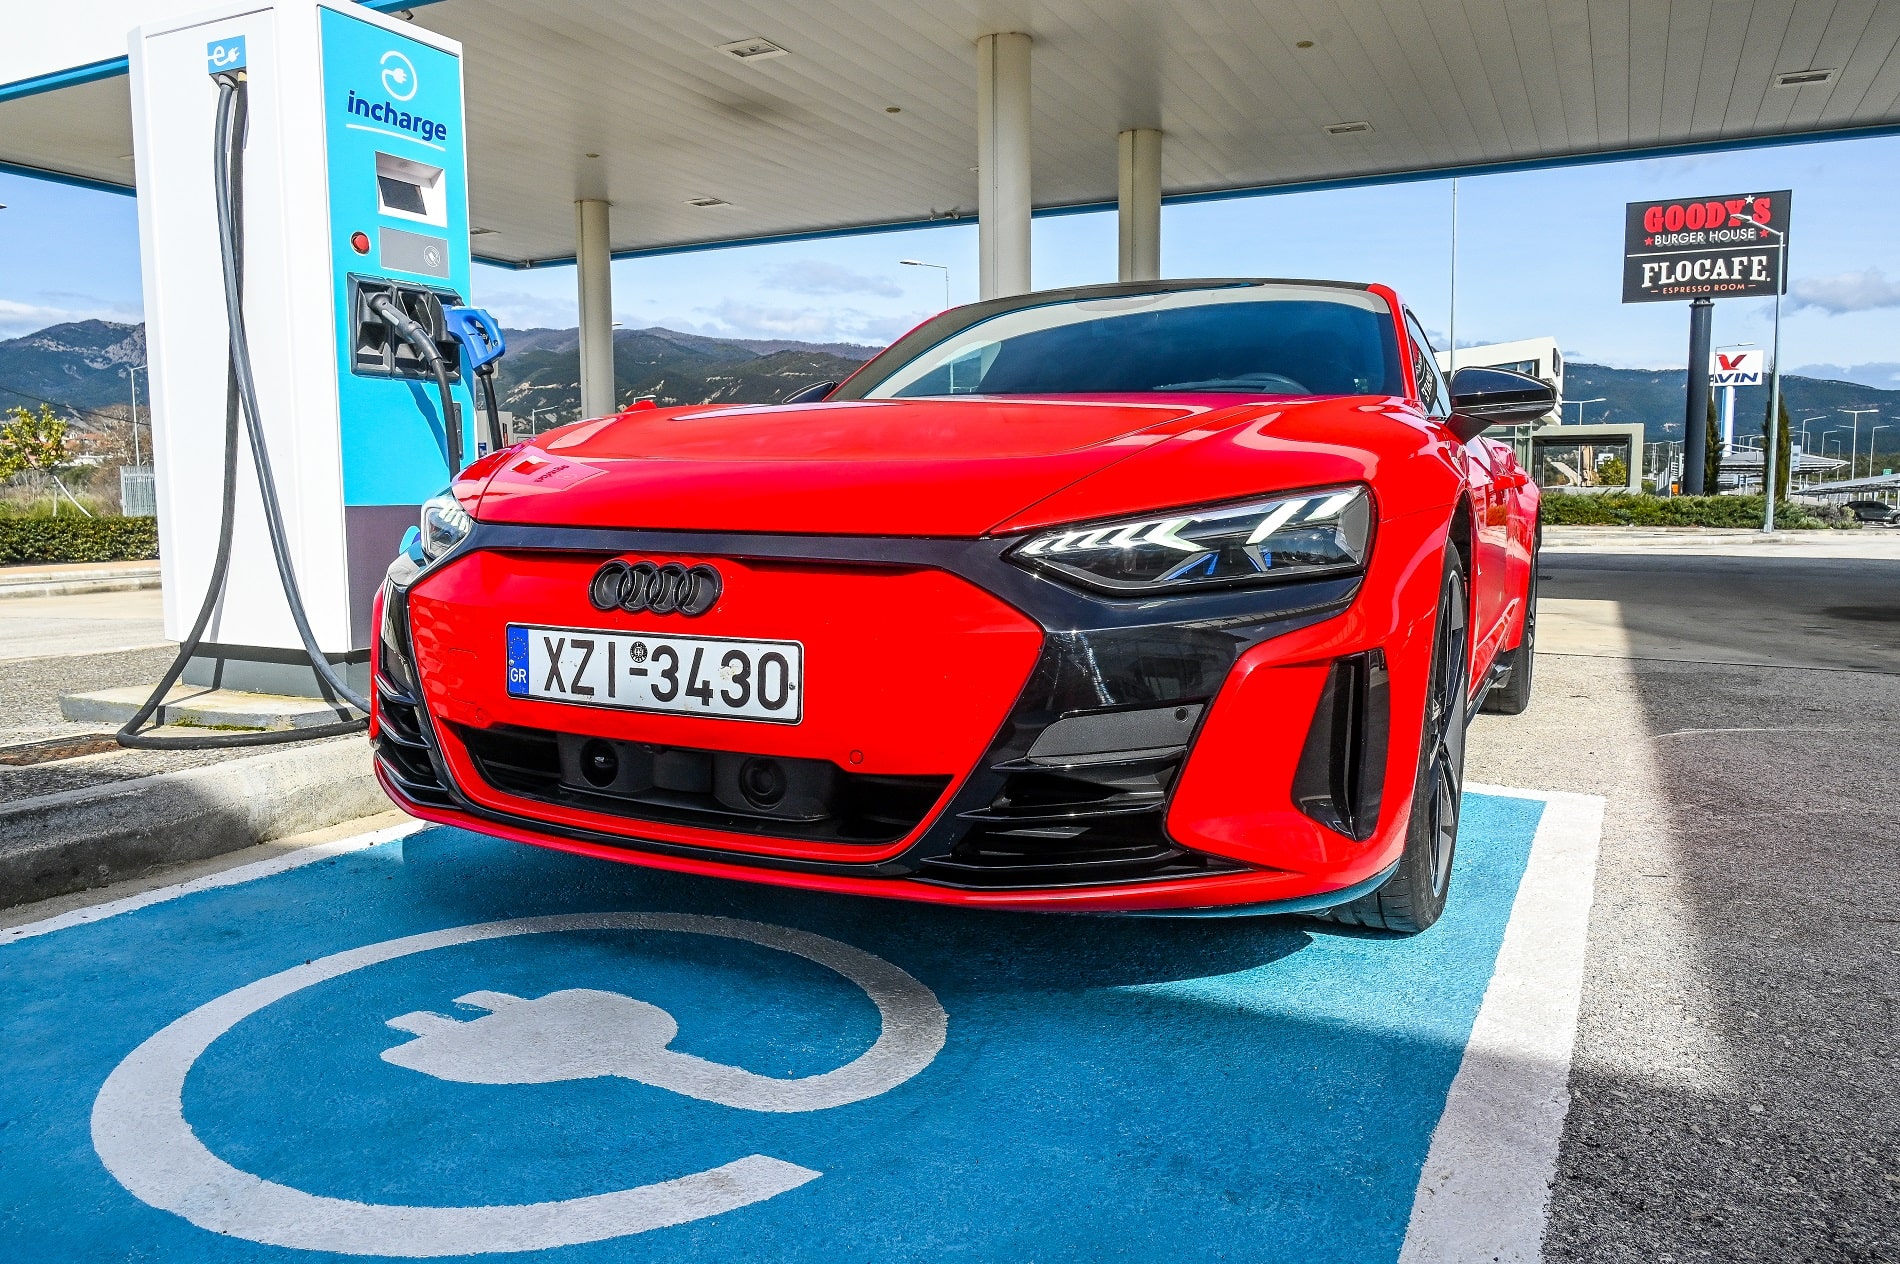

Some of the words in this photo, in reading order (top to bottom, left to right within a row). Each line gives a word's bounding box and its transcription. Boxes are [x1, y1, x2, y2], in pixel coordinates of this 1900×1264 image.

[348, 90, 446, 141] incharge
[1654, 232, 1705, 246] BURGER
[1709, 228, 1756, 242] HOUSE
[1663, 285, 1711, 294] ESPRESSO
[1714, 283, 1745, 292] ROOM
[510, 667, 527, 684] GR
[543, 636, 789, 711] XZI-3430
